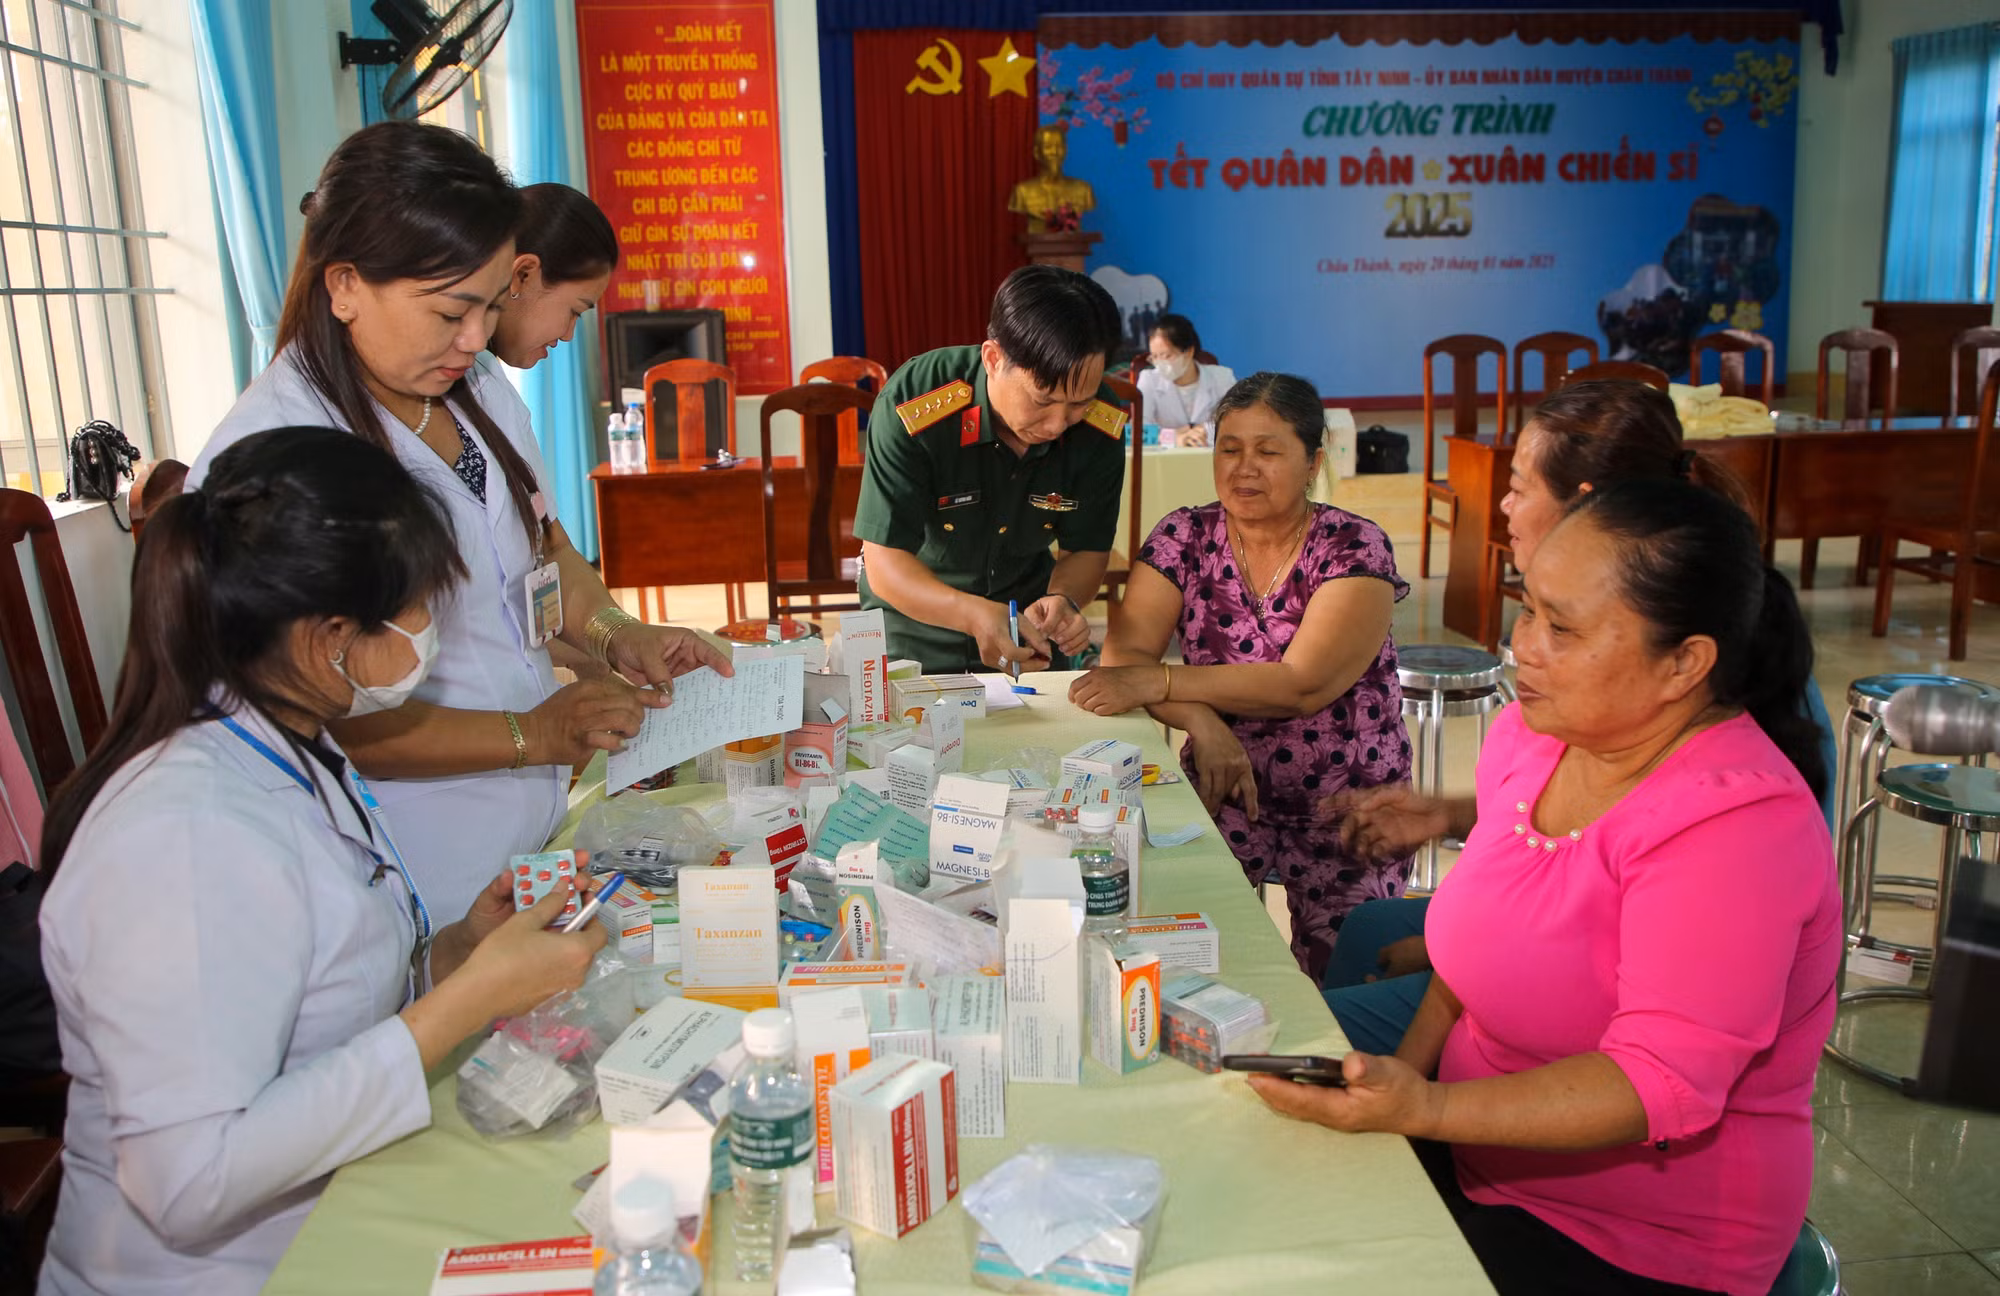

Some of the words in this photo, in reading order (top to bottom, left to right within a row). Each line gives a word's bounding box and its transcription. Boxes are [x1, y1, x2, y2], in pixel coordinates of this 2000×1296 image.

[716, 19, 743, 42] KẾT
[601, 51, 619, 73] LÀ
[622, 51, 652, 74] MỘT
[655, 47, 710, 72] TRUYỀN
[712, 47, 758, 71] THỐNG
[1207, 72, 1235, 88] HUY
[1240, 68, 1281, 89] QUÂN
[1344, 69, 1372, 87] TÂY
[1377, 70, 1410, 87] NINH
[1449, 68, 1478, 86] BAN
[1481, 67, 1520, 85] NHÂN
[1524, 66, 1552, 85] DÂN
[1556, 66, 1604, 87] HUYỆN
[625, 80, 653, 103] CỰC
[678, 77, 705, 102] QUÝ
[709, 77, 737, 99] BÁU
[597, 107, 624, 130] CỦA
[627, 107, 665, 130] ĐẢNG
[667, 107, 685, 128] VÀ
[689, 105, 716, 128] CỦA
[719, 106, 747, 127] DÂN
[750, 109, 768, 127] TA
[1302, 100, 1443, 137] CHƯƠNG
[1451, 95, 1556, 136] TRÌNH
[627, 137, 654, 158] CÁC
[657, 134, 694, 157] ĐỒNG
[697, 135, 720, 156] CHÍ
[723, 135, 743, 156] TỪ
[613, 169, 658, 187] TRUNG
[661, 166, 697, 186] ƯƠNG
[701, 162, 728, 184] ĐẾN
[731, 163, 758, 184] CÁC
[1148, 141, 1209, 190] TẾT
[1221, 147, 1326, 192] QUÂN
[1340, 146, 1414, 187] DÂN
[1447, 144, 1546, 184] XUÂN
[1557, 134, 1656, 183] CHIẾN
[632, 195, 655, 215] CHI
[659, 193, 678, 216] BỘ
[681, 190, 709, 214] CẦN
[712, 191, 743, 213] PHẢI
[1384, 191, 1473, 239] 2025
[620, 221, 643, 243] GIỮ
[646, 223, 669, 242] GÌN
[672, 222, 689, 243] SỰ
[693, 221, 730, 241] ĐOÀN
[732, 218, 759, 240] KẾT
[626, 248, 661, 270] NHẤT
[666, 250, 688, 269] TRÍ
[690, 247, 717, 268] CỦA
[721, 246, 756, 267] ĐẢ
[1500, 255, 1525, 270] năm
[700, 279, 727, 296] CON
[795, 759, 821, 769] B1-B6-B1
[936, 811, 997, 831] MAGNESI-B6
[838, 873, 874, 881] PREDNISON
[935, 860, 990, 879] MAGNESI-B
[695, 927, 762, 942] Taxanzan
[853, 904, 865, 959] PREDNISON
[1139, 987, 1147, 1047] PREDNISON
